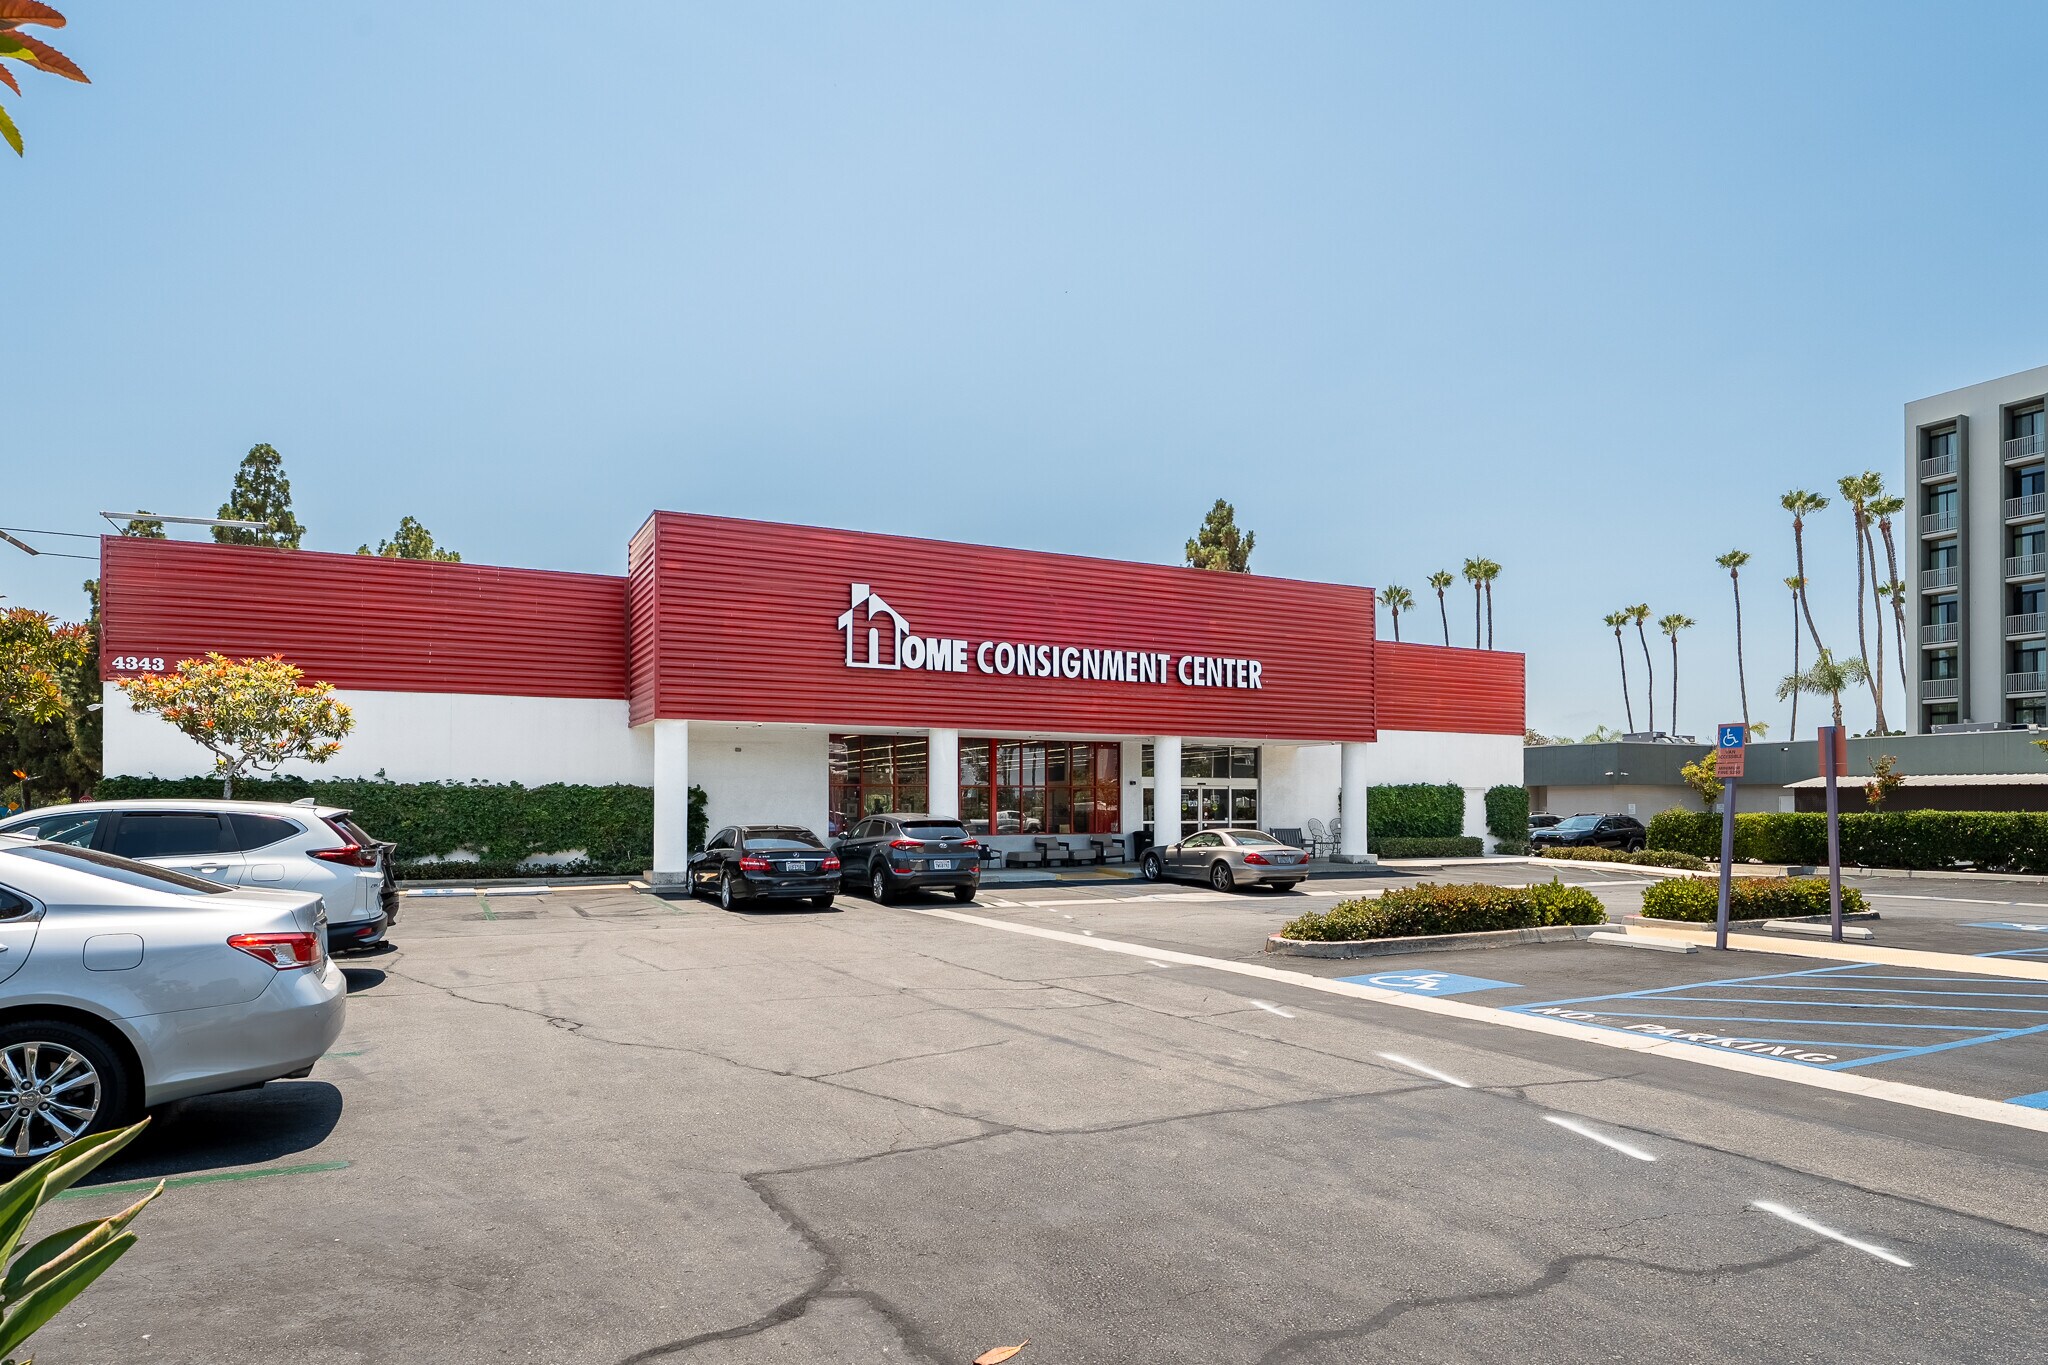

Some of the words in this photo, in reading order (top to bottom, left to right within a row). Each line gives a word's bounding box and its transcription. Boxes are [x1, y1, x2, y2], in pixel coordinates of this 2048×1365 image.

[111, 656, 165, 671] 4343
[976, 641, 1171, 684] CONSIGNMENT
[1178, 655, 1263, 689] CENTER
[1530, 1008, 1596, 1019] NO
[1623, 1023, 1838, 1062] PARKING
